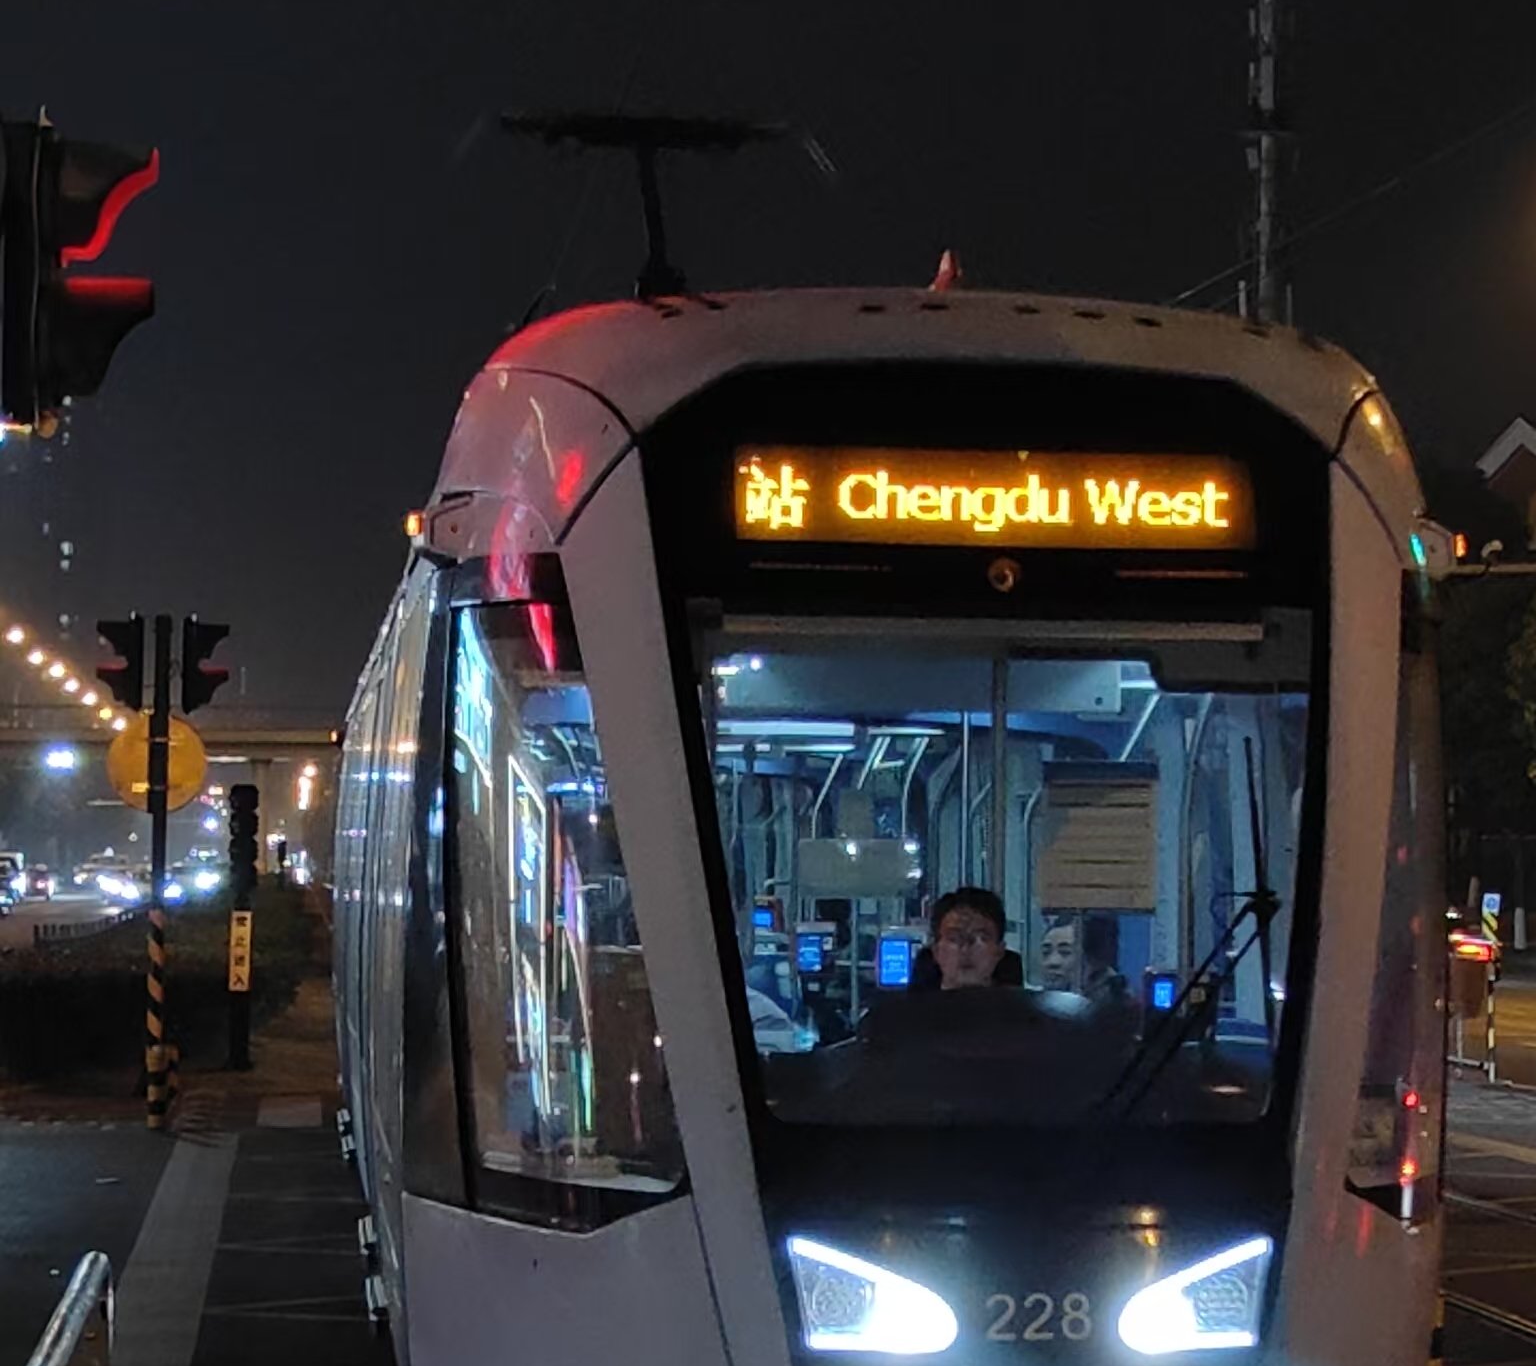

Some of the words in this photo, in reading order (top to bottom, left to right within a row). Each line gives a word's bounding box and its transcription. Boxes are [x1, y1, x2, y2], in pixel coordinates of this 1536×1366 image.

[744, 457, 810, 530] 站
[838, 471, 1072, 532] Chengdu
[1084, 478, 1229, 528] West
[985, 1292, 1092, 1341] 228
